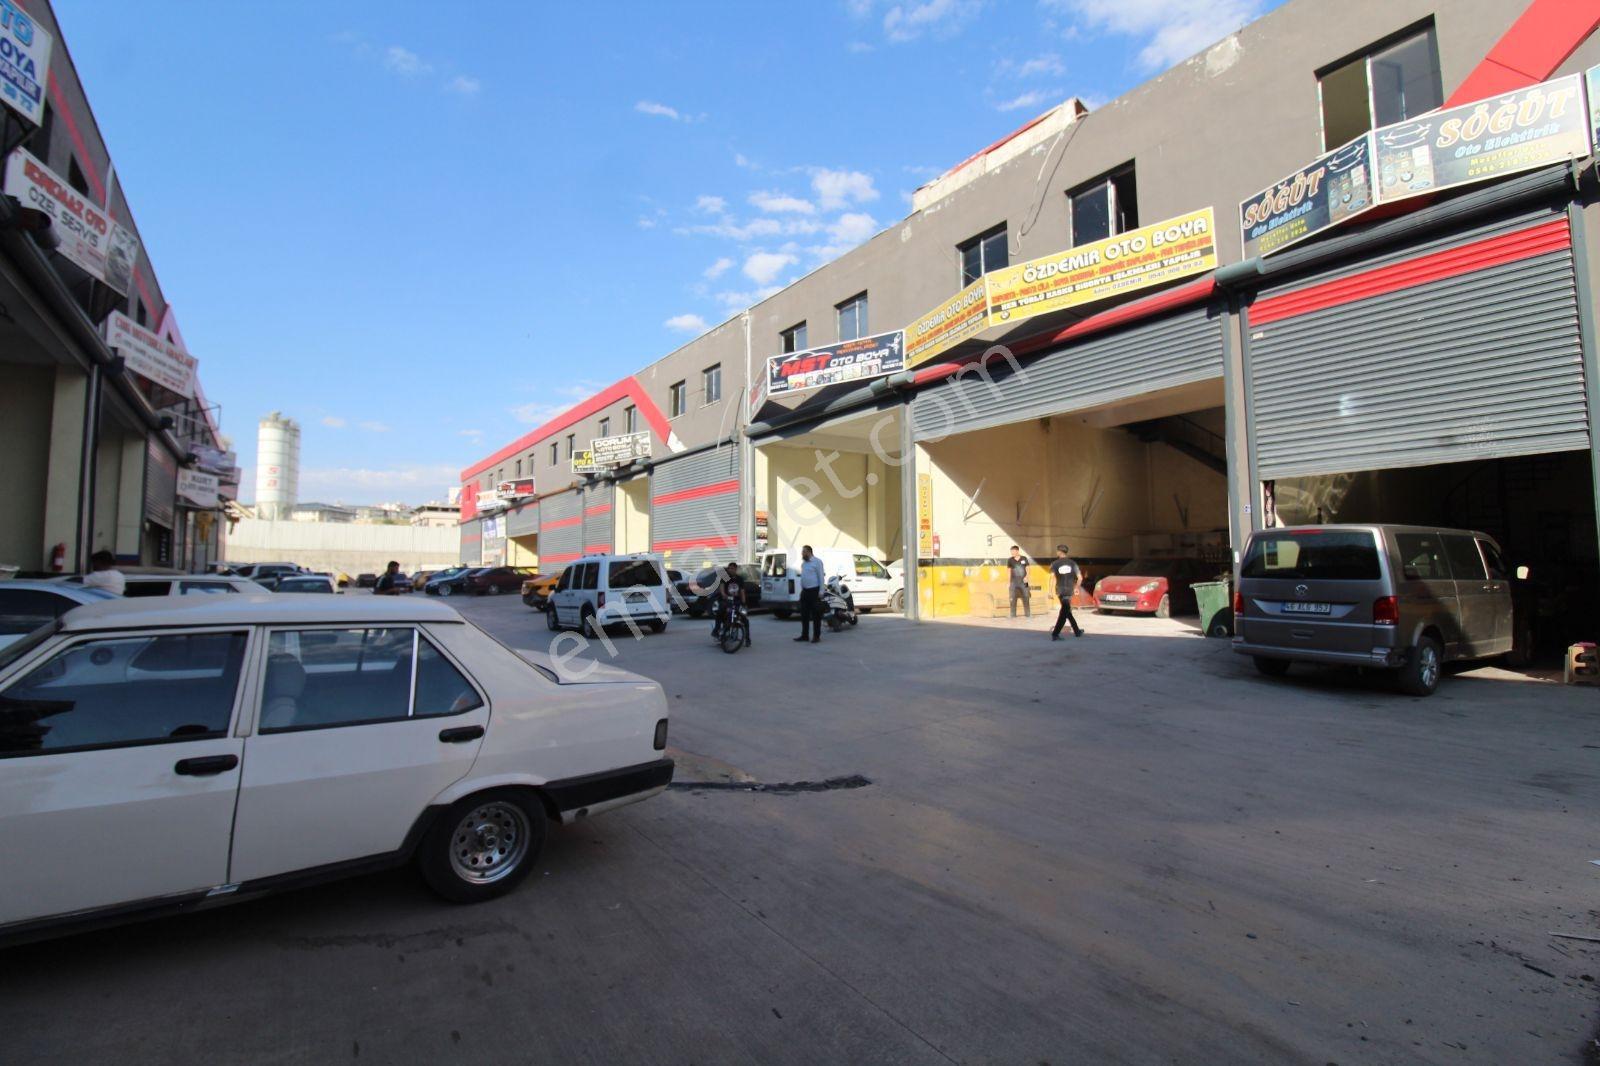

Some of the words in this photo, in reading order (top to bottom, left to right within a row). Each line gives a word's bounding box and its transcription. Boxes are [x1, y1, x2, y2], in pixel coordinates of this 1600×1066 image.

[1436, 87, 1576, 148] SÖĞÜT
[1455, 143, 1481, 158] Oto
[1243, 167, 1325, 229] SÖĞÜT
[1023, 249, 1101, 283] ÖZDEMİR
[1105, 236, 1146, 260] OTO
[1152, 218, 1207, 248] BOYA
[830, 355, 854, 367] OTO
[855, 348, 889, 362] BOYA
